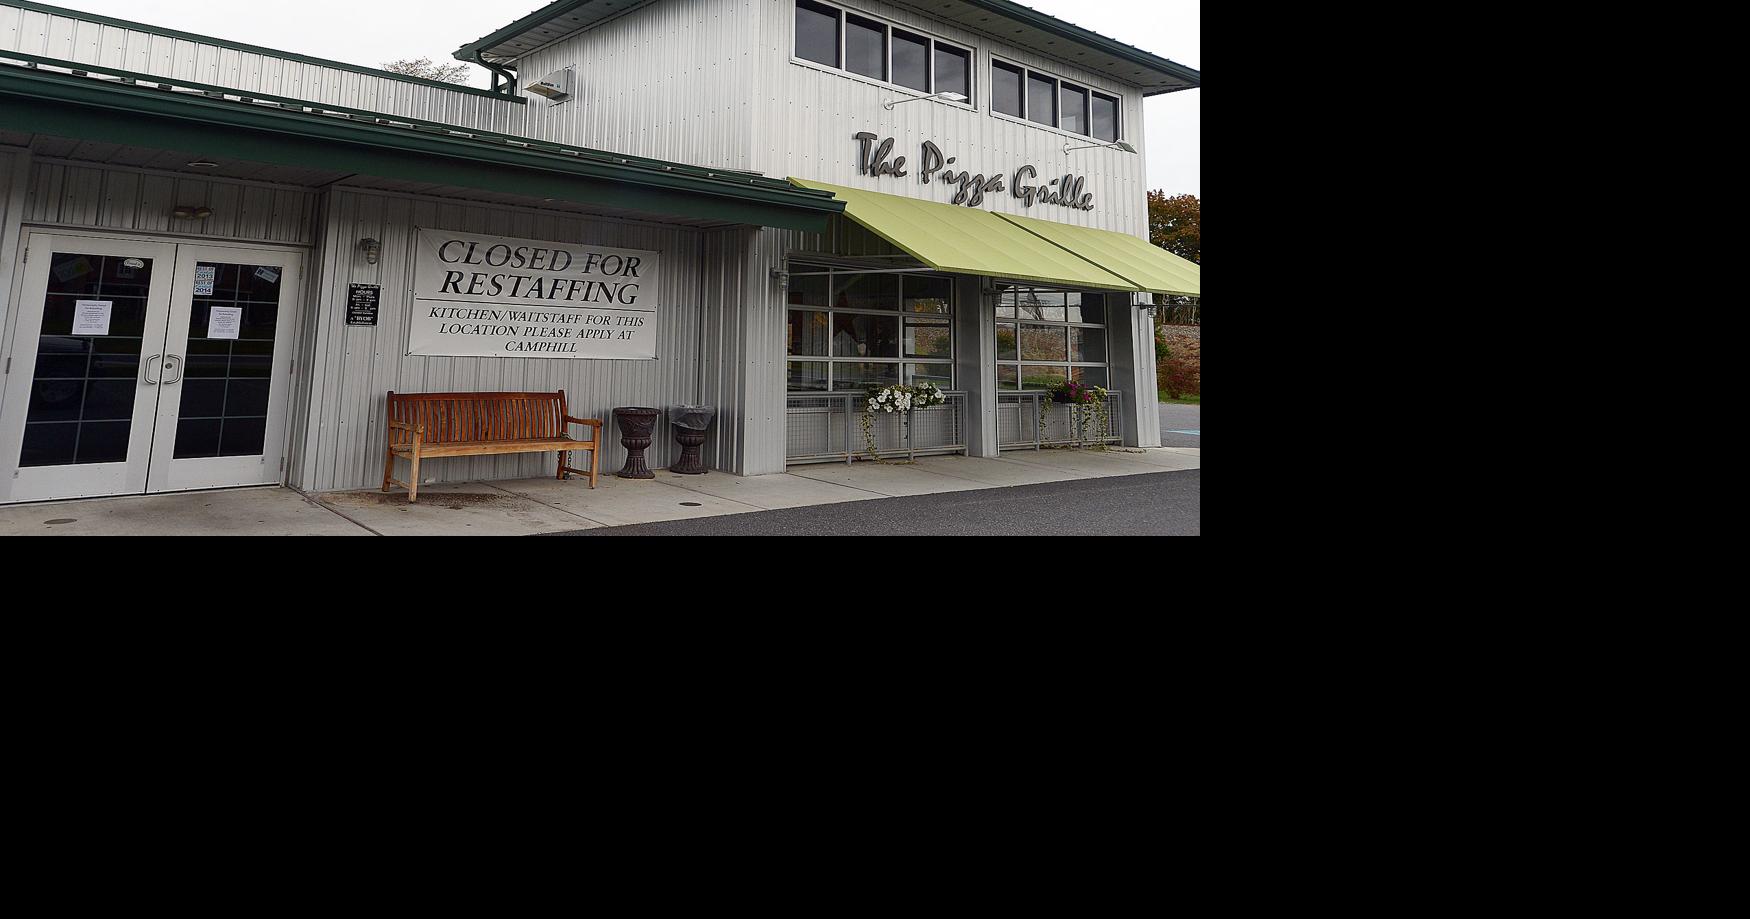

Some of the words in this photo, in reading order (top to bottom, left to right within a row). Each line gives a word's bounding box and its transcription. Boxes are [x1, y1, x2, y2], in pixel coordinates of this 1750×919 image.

[856, 131, 907, 178] The
[921, 140, 1005, 207] Pizza
[1012, 164, 1094, 211] Grille
[438, 240, 572, 272] CLOSED
[582, 252, 641, 278] FOR
[438, 270, 640, 305] RESTAFFING
[428, 307, 582, 325] KITCHEN/WAITSTAFF
[586, 315, 611, 326] FOR
[617, 316, 645, 327] THIS
[439, 323, 519, 337] LOCATION
[523, 327, 572, 339] PLEASE
[576, 329, 615, 340] APPLY
[617, 330, 635, 340] AT
[504, 340, 578, 353] CAMPHILL
